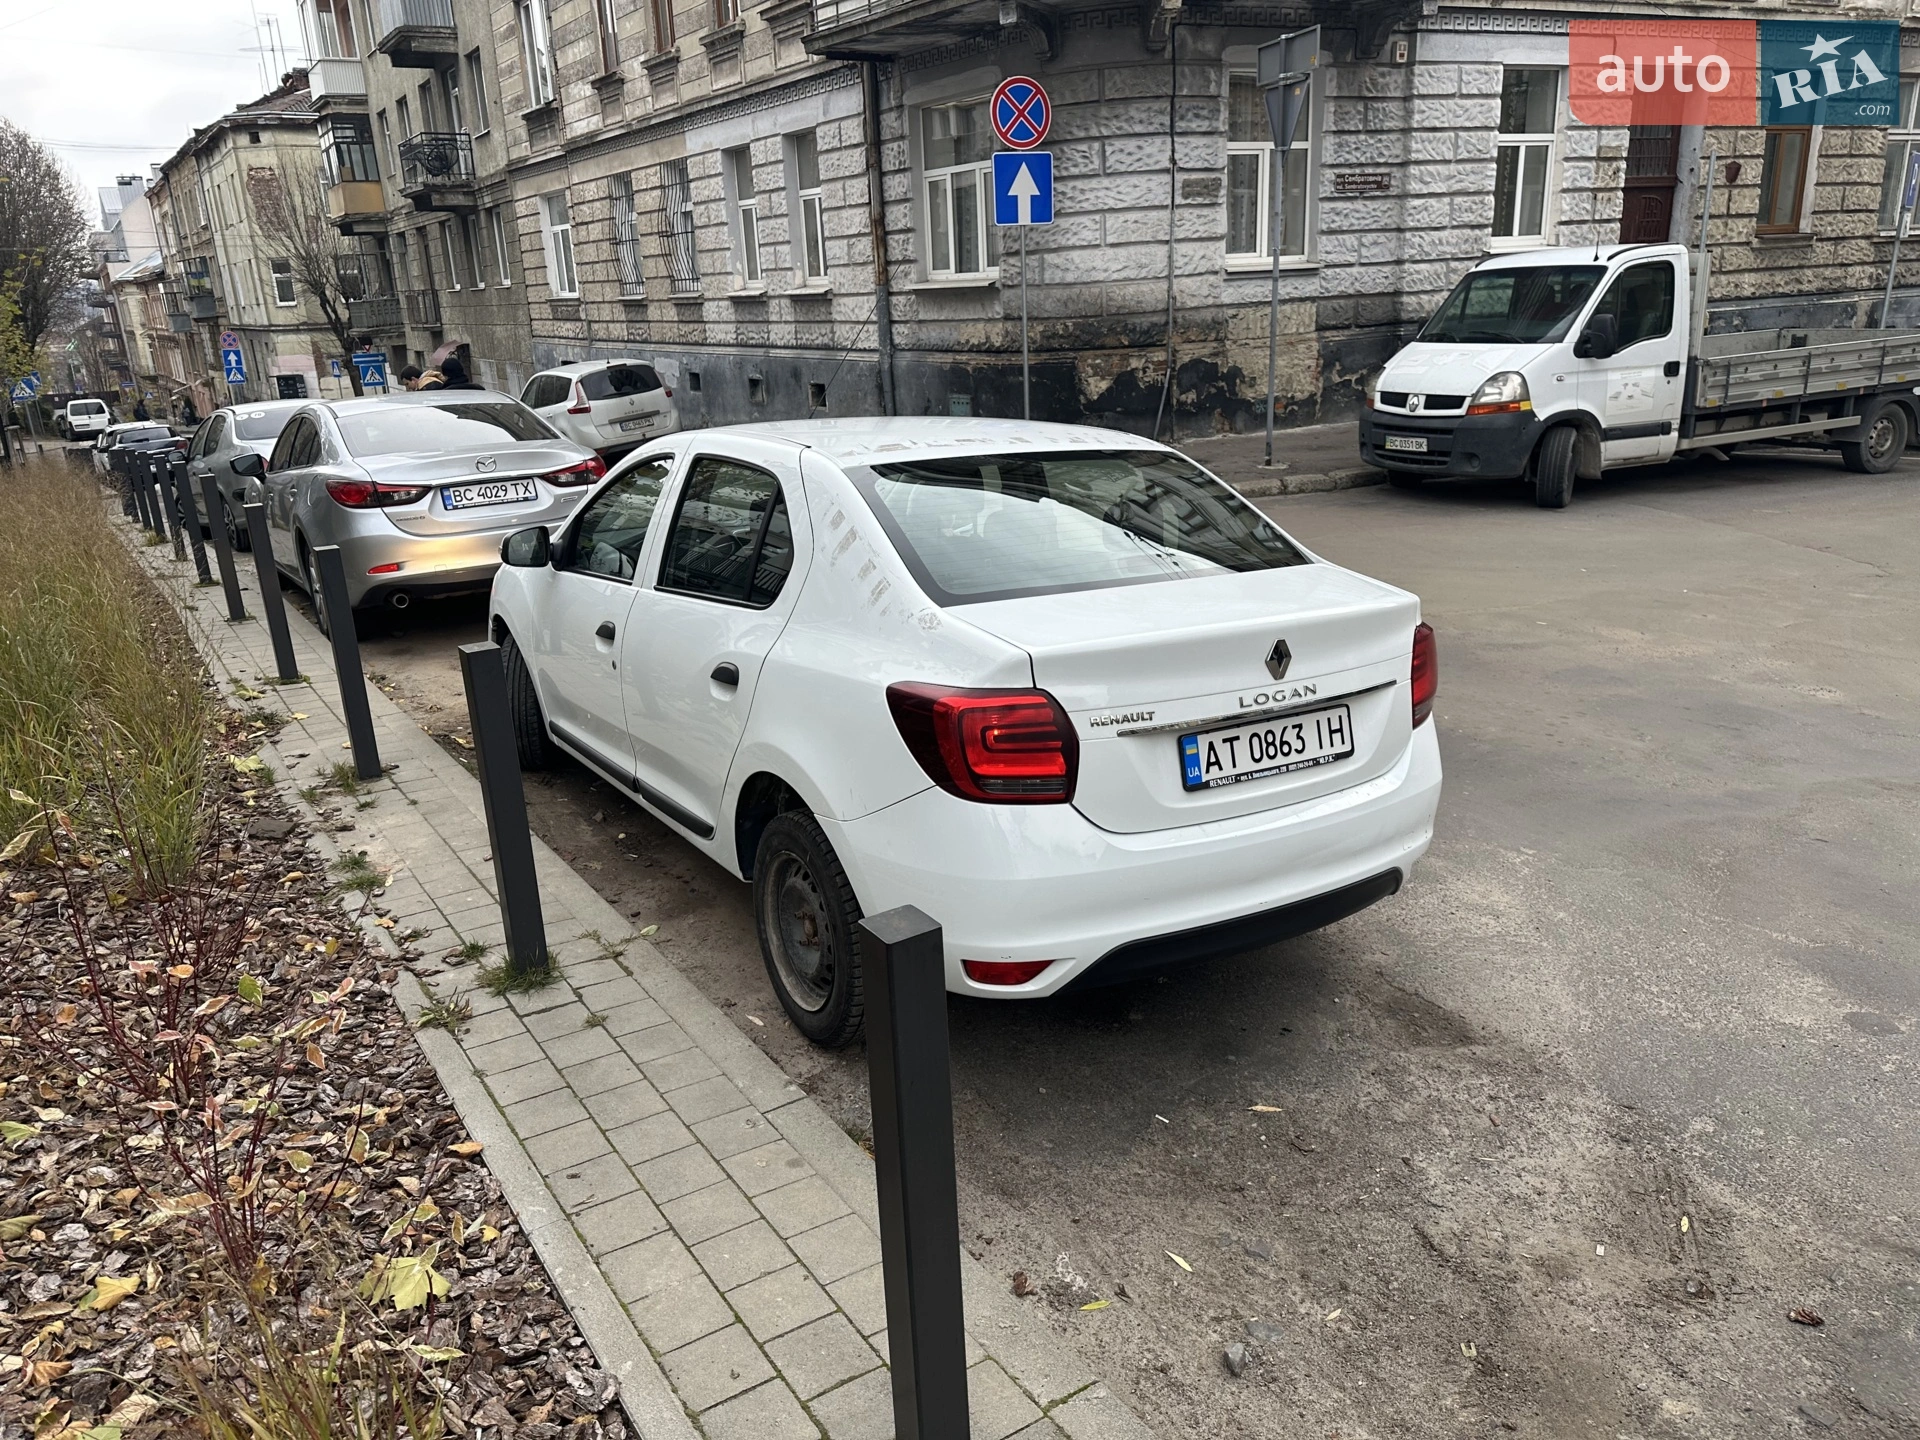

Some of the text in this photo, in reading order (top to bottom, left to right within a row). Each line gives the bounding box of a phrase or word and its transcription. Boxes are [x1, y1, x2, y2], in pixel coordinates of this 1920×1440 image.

[1390, 439, 1425, 450] BC 0351 BK
[453, 488, 474, 503] BC
[477, 484, 508, 500] 4029
[510, 481, 532, 496] TX
[1238, 683, 1317, 708] LOGAN
[1089, 711, 1156, 727] RENAULT
[1205, 714, 1346, 775] AT 0863 IH
[1187, 766, 1201, 777] UA
[1209, 775, 1236, 788] RENAULT
